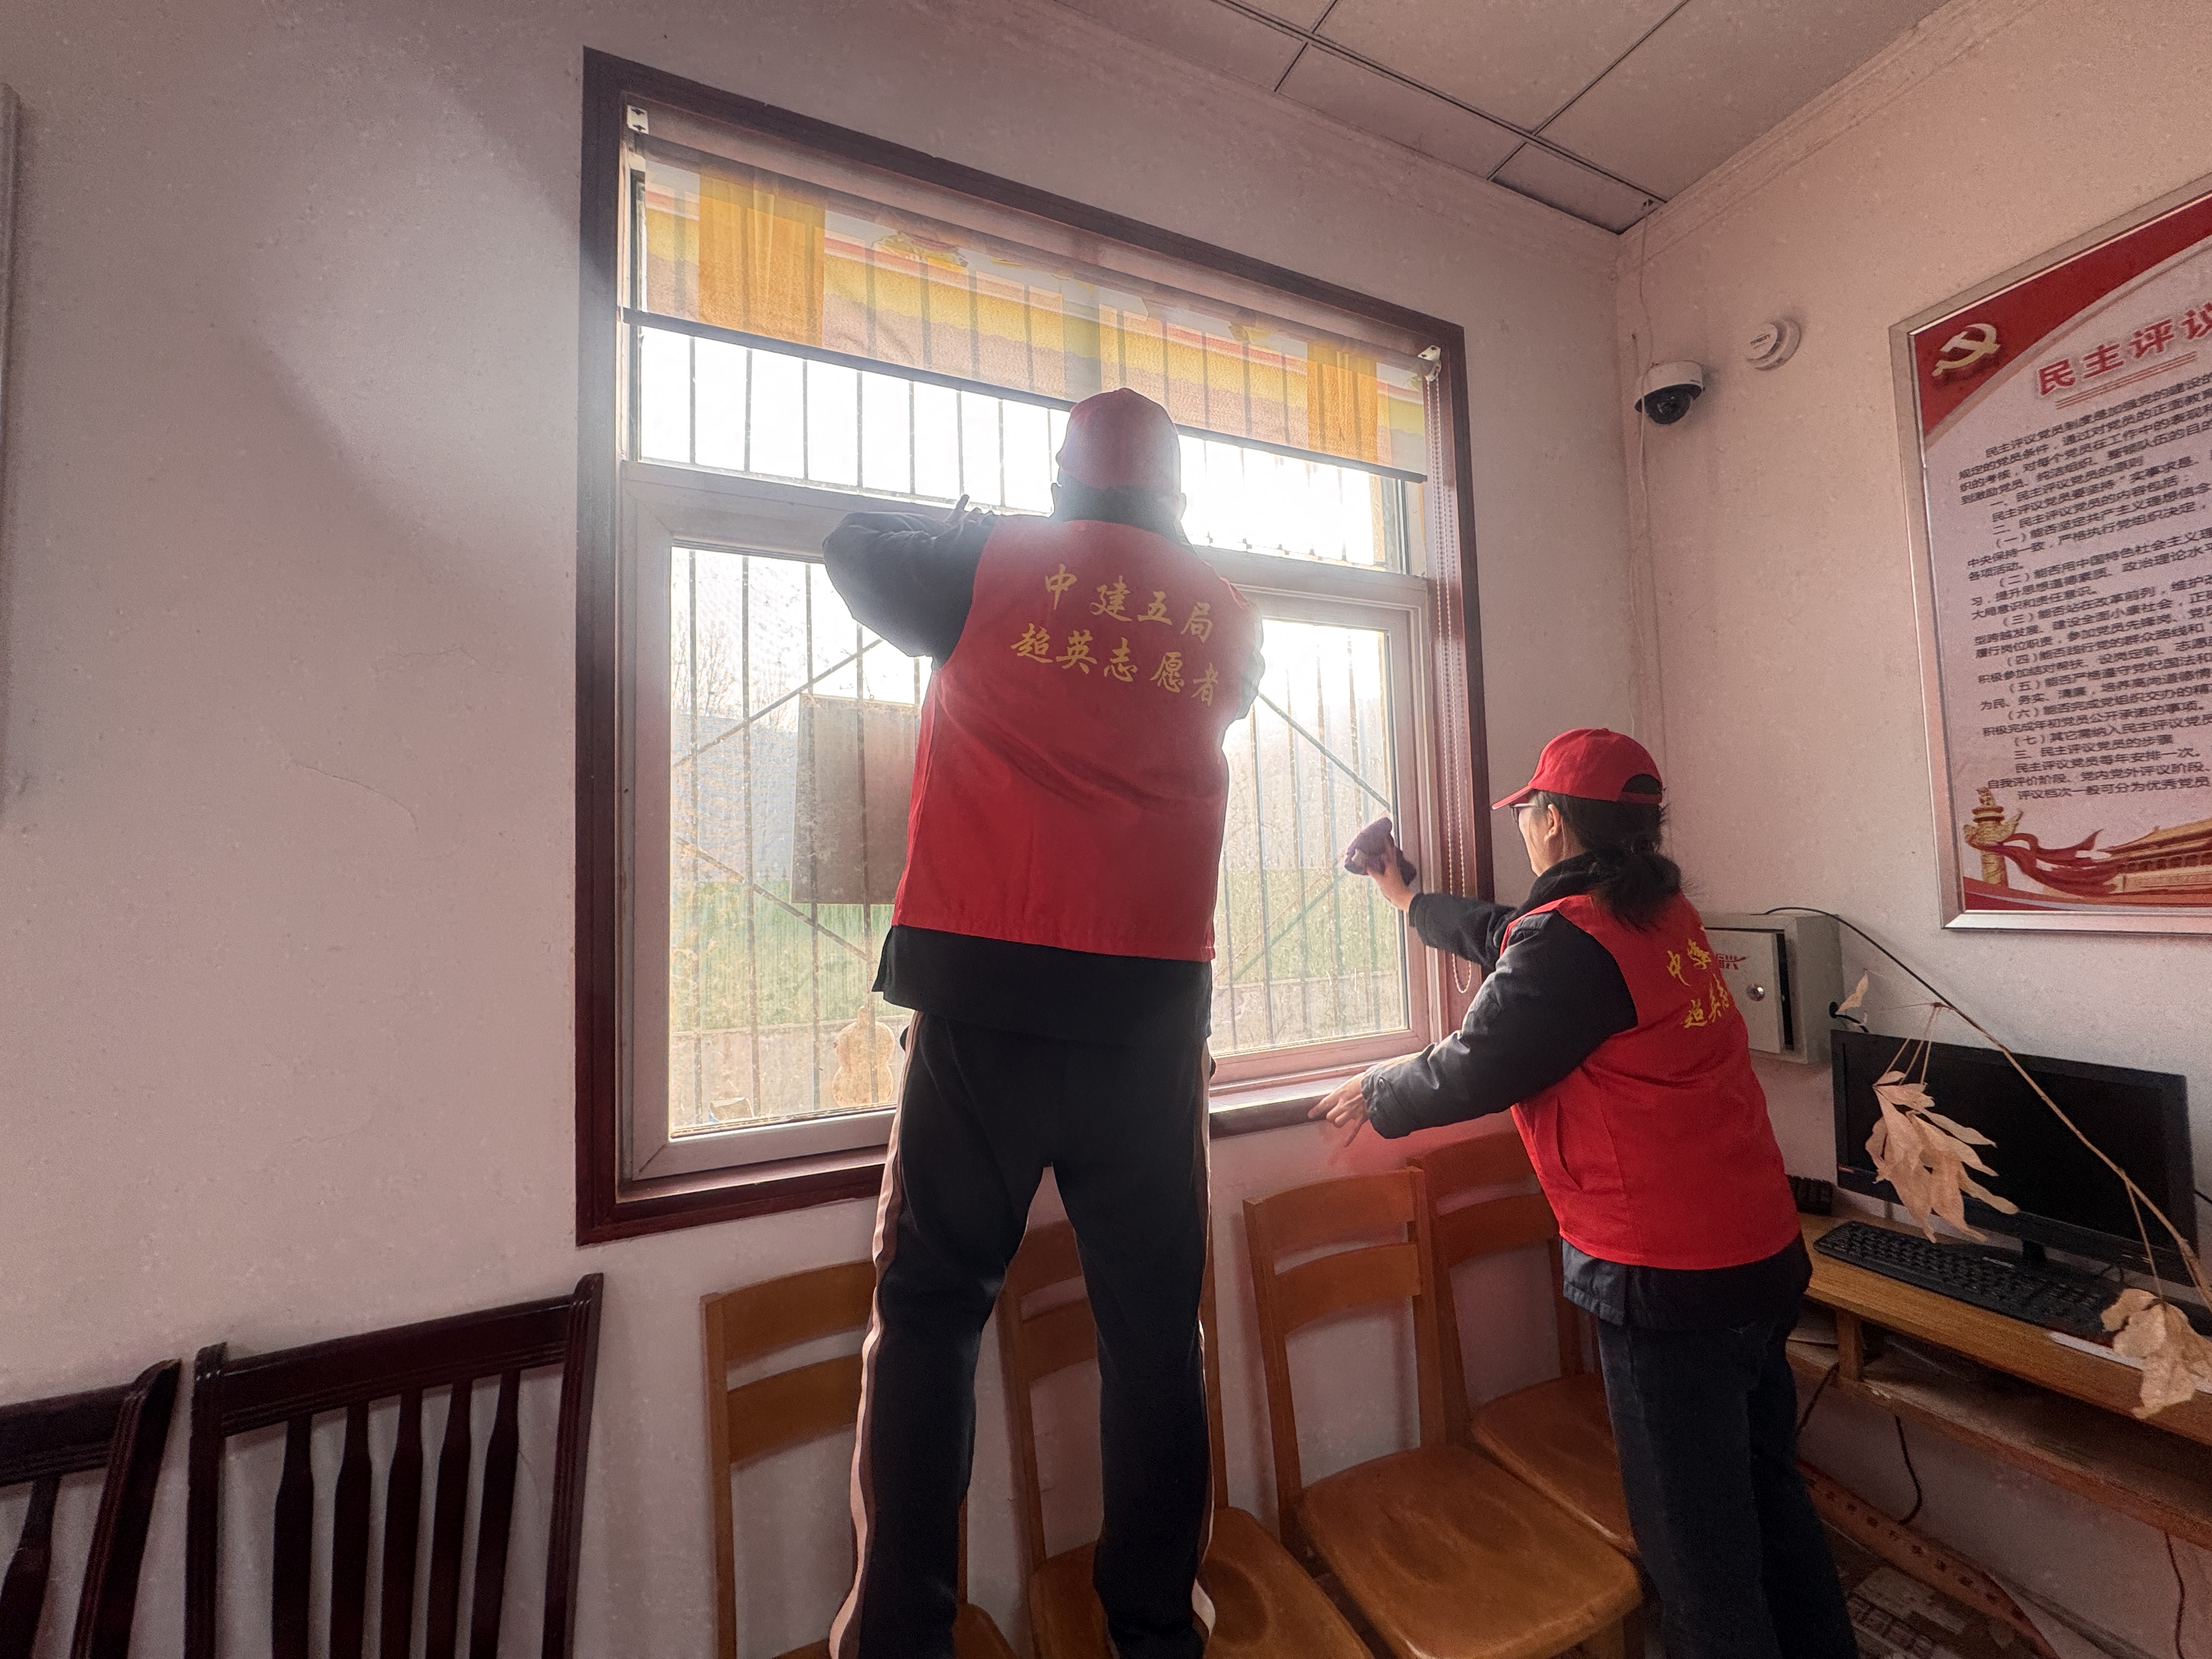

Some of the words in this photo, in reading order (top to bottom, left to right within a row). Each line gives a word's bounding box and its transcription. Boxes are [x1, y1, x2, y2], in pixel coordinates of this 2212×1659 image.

[2039, 302, 2212, 396] 民主评议
[1989, 455, 2143, 506] 一、民主评议党员的原则
[1045, 563, 1214, 644] 中建五局
[1011, 623, 1220, 707] 超英志愿者
